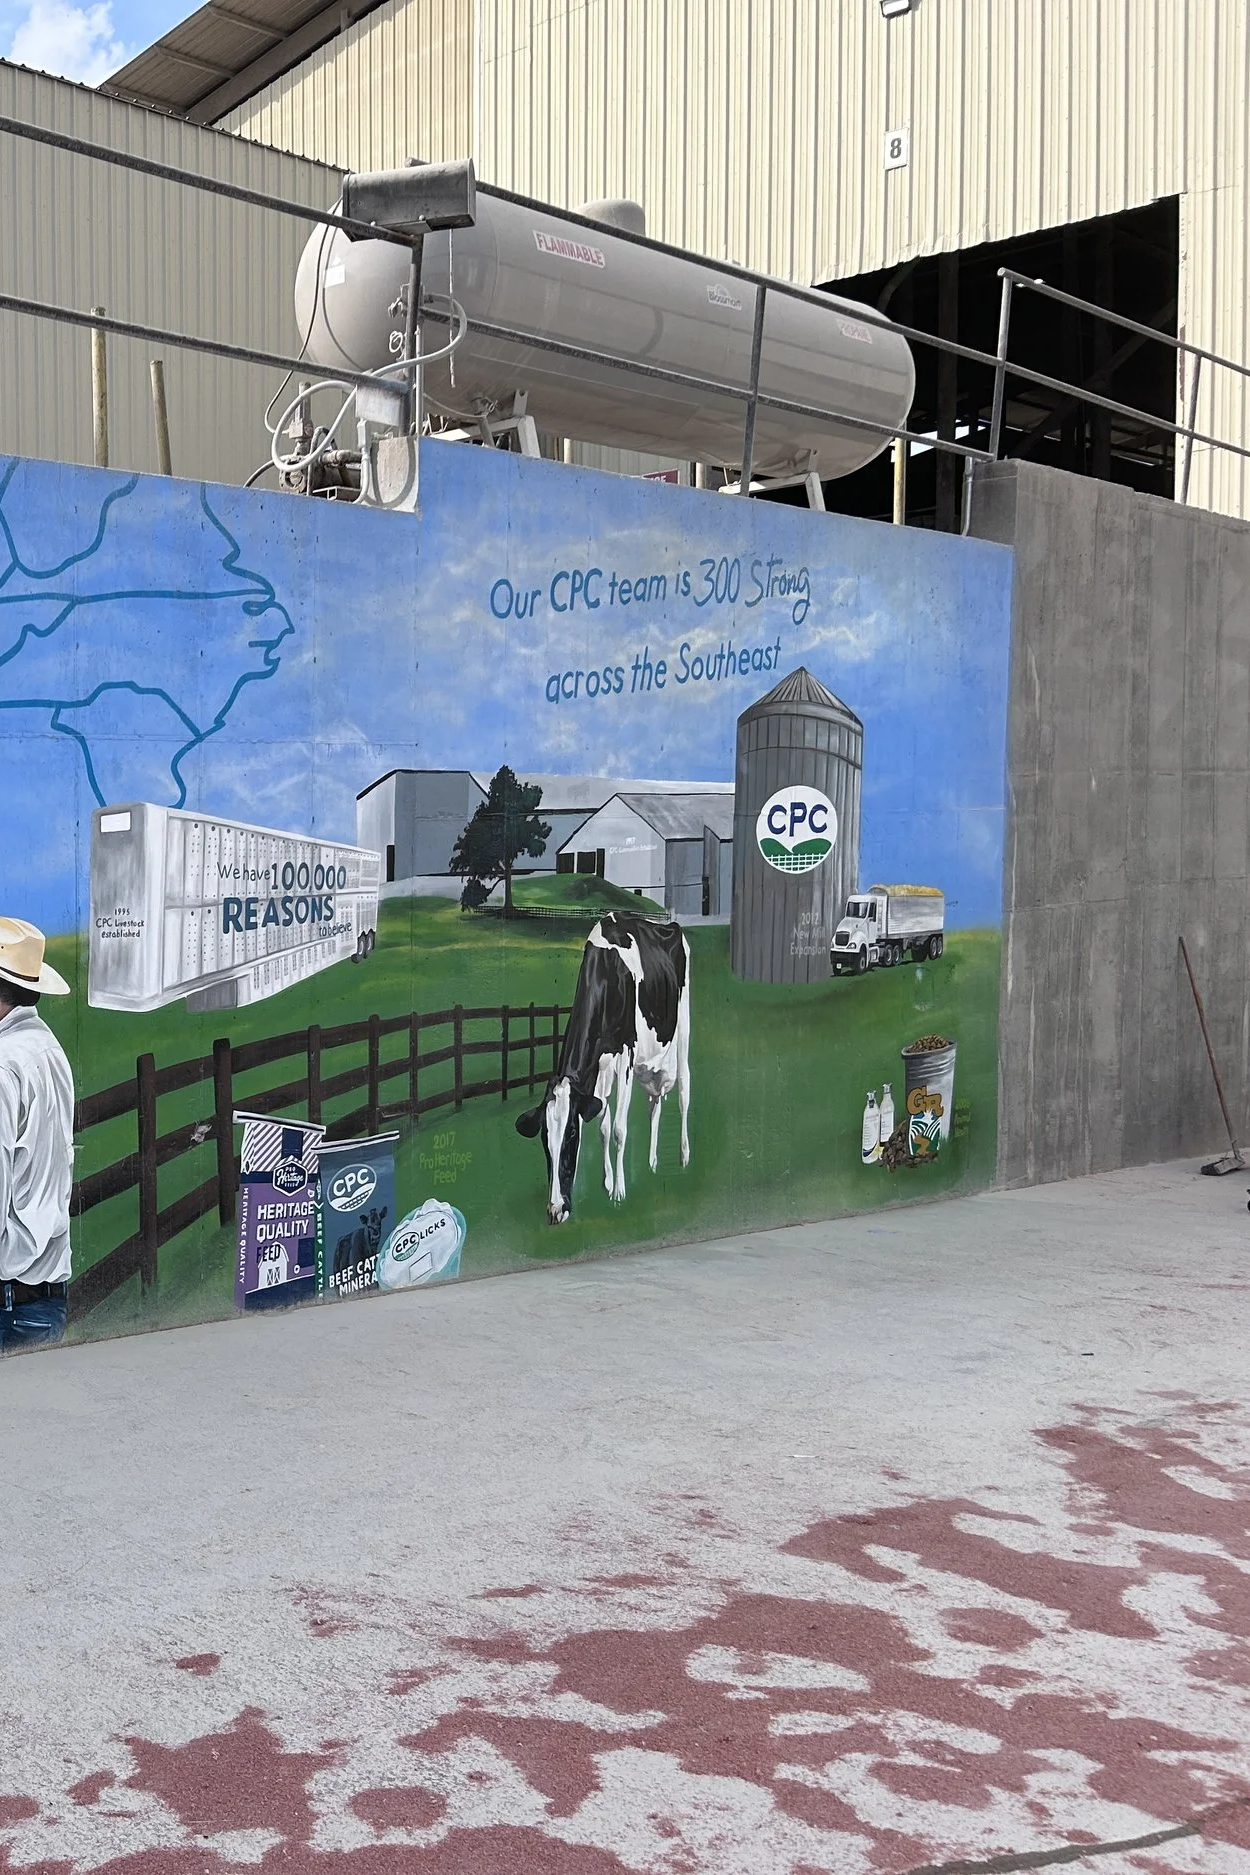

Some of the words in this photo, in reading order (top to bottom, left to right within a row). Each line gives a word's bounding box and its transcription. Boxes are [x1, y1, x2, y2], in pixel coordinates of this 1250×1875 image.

[890, 137, 902, 159] 8
[536, 233, 604, 266] FLAMMABLE
[490, 578, 541, 619] Our
[550, 568, 603, 613] CPC
[609, 571, 667, 606] team
[675, 571, 691, 598] is
[693, 556, 741, 607] 300
[744, 553, 811, 625] Strong
[546, 664, 625, 704] across
[631, 646, 668, 693] the
[675, 636, 782, 684] Southeast
[767, 801, 829, 837] CPC
[217, 862, 240, 880] We
[242, 864, 271, 882] have
[271, 861, 347, 893] 100,000
[95, 917, 113, 928] CPC
[114, 918, 145, 927] Livestock
[114, 907, 130, 916] 1995
[222, 895, 334, 934] REASONS
[101, 929, 141, 938] established
[793, 926, 810, 940] New
[790, 942, 827, 959] Expansion
[433, 1131, 457, 1149] 2017
[333, 1168, 370, 1196] CPC
[433, 1168, 457, 1185] Feed
[257, 1201, 315, 1220] HERITAGE
[257, 1219, 310, 1243] QUALITY
[395, 1234, 416, 1254] CPC
[419, 1218, 446, 1240] LICKS
[256, 1244, 281, 1263] FEED
[329, 1265, 354, 1288] BEEF
